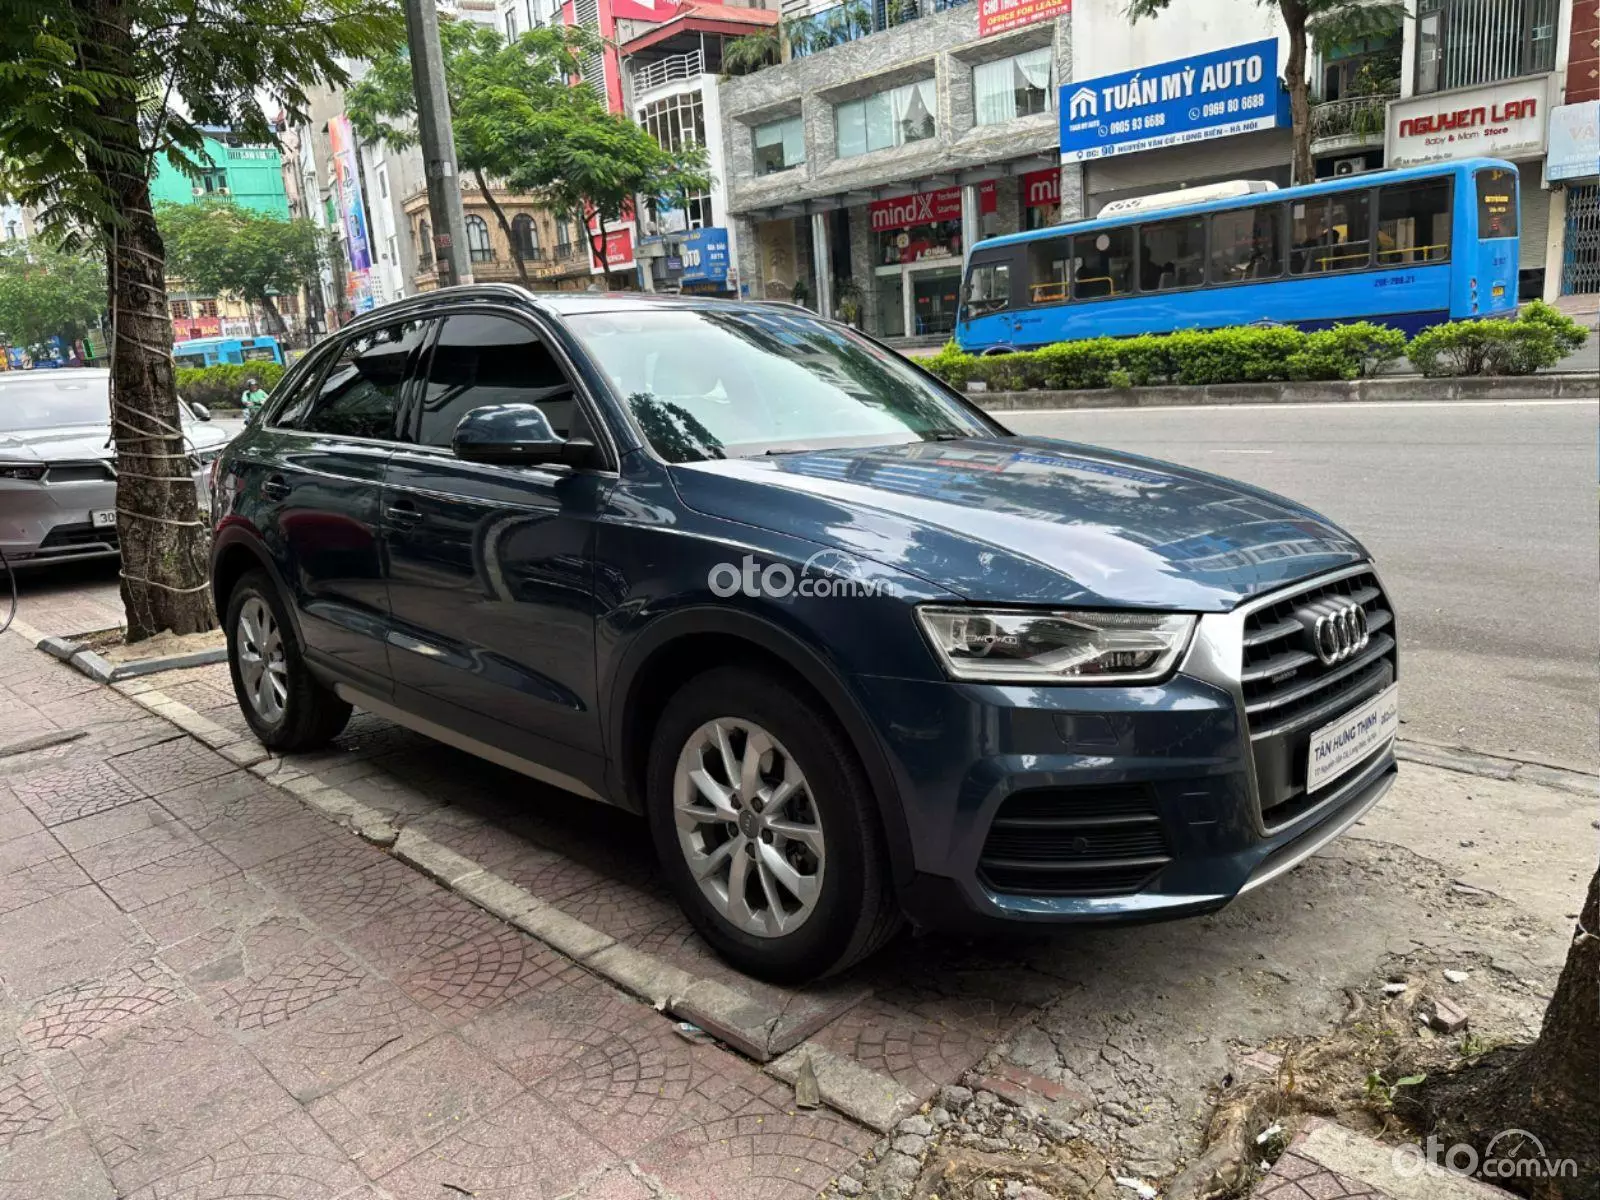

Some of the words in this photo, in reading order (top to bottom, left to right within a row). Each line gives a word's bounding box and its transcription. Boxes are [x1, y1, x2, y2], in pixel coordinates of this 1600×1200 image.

[987, 11, 1014, 25] OFFICE
[1017, 6, 1033, 17] FOR
[1102, 73, 1157, 113] TUẤN
[1161, 66, 1196, 101] MỲ
[1201, 55, 1262, 93] AUTO
[1227, 98, 1239, 112] 80
[1491, 98, 1537, 123] LAN
[1102, 144, 1115, 156] 90
[1181, 132, 1202, 142] LONG
[1425, 136, 1446, 146] Baby
[1458, 131, 1480, 141] Mom
[1484, 127, 1509, 137] Store
[872, 192, 935, 228] mindX
